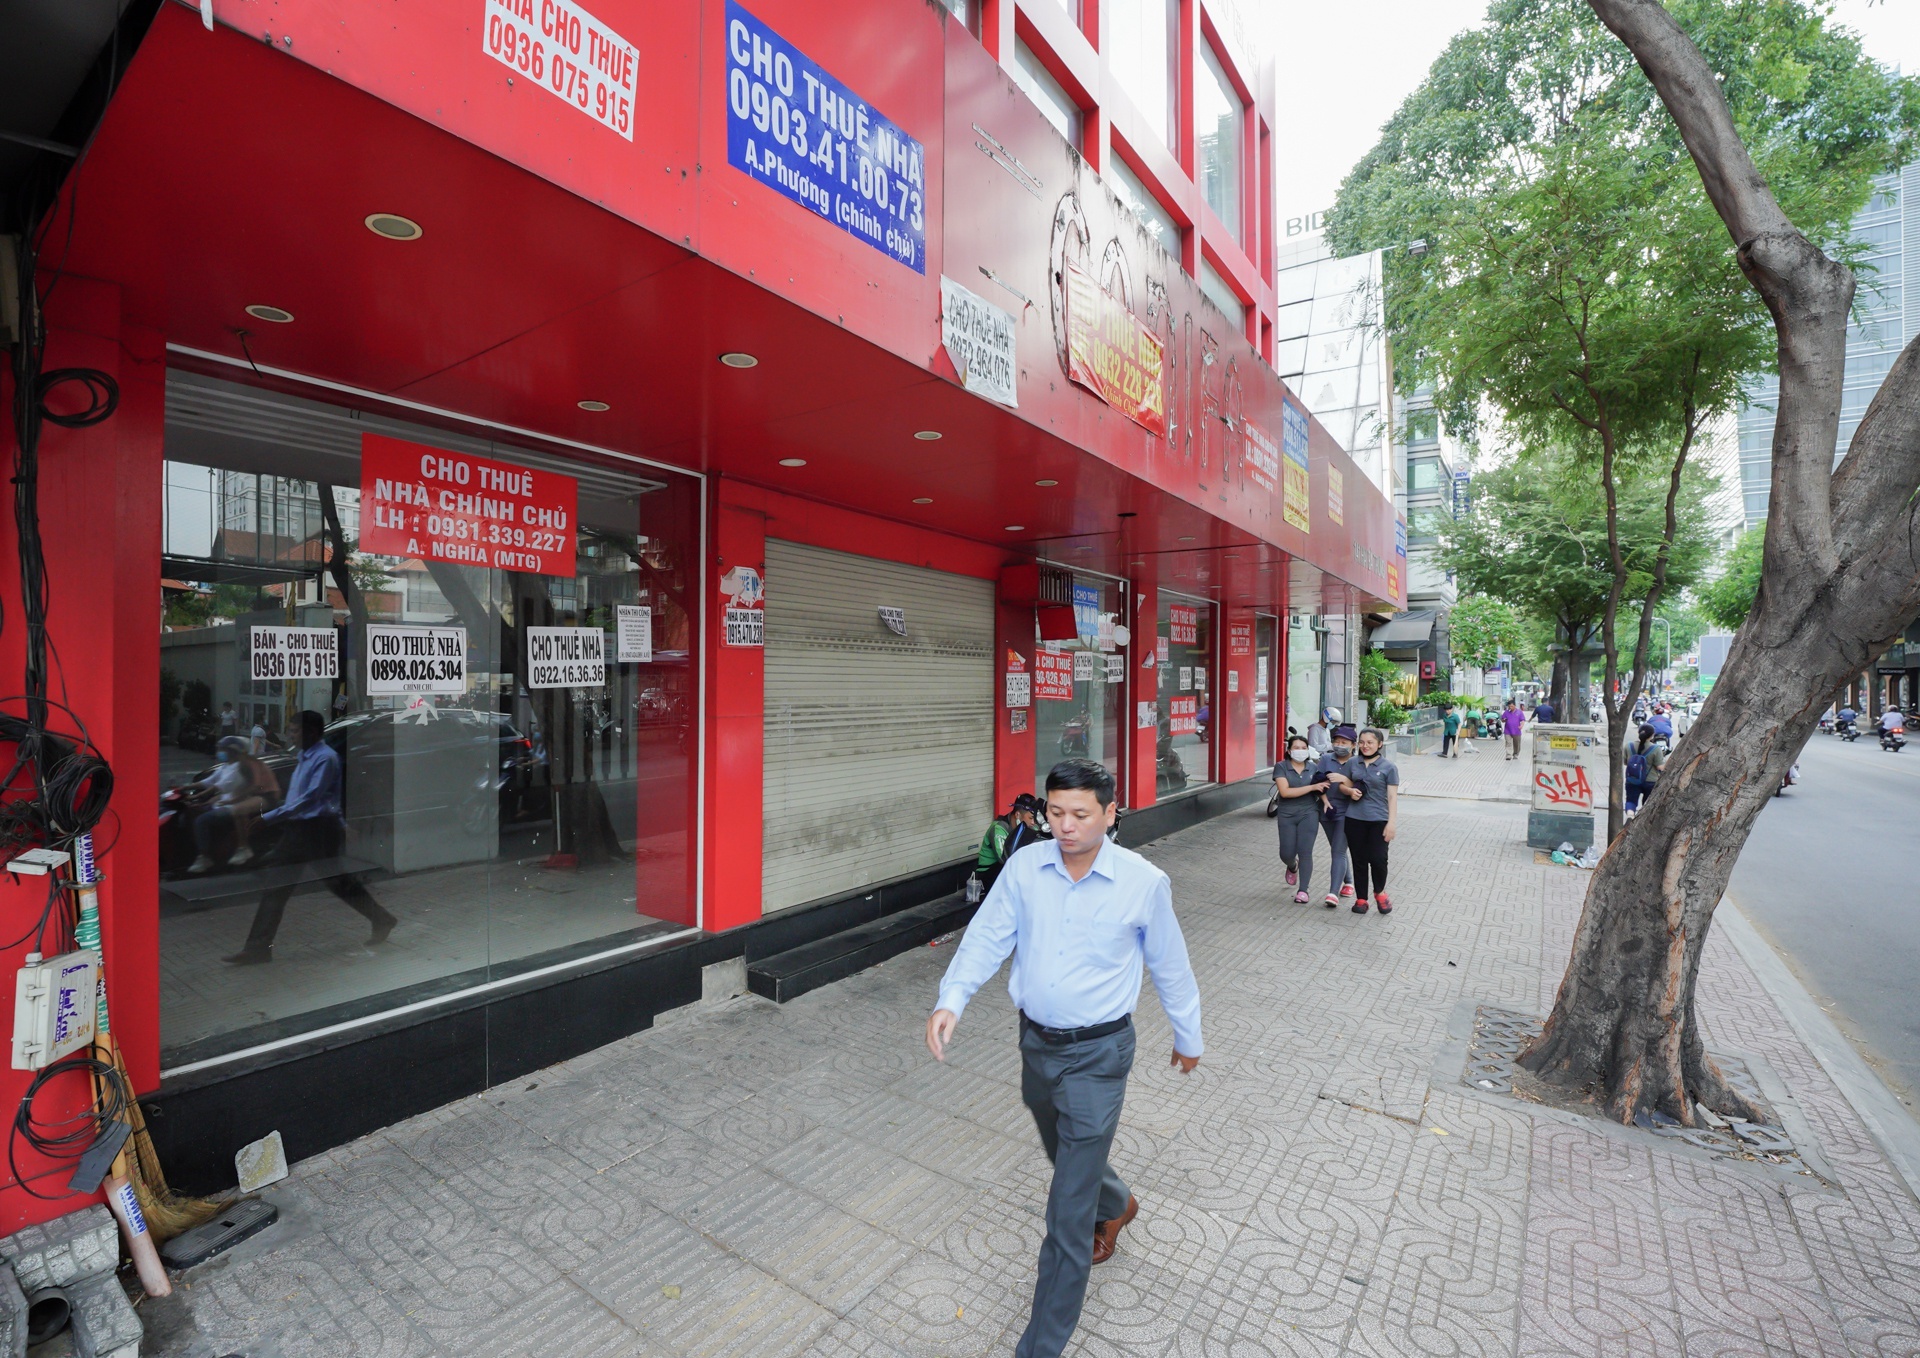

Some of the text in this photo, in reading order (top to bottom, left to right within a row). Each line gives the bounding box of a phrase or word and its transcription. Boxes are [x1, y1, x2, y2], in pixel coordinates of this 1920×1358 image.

[542, 0, 581, 55] CHO
[588, 27, 633, 91] THUÊ
[489, 14, 629, 133] 0936 075 915
[730, 19, 922, 189] CHO THUÊ NHÀ
[730, 68, 923, 231] 0903.41.00.73
[745, 138, 915, 265] A.Phượng (chính chủ)
[949, 294, 1010, 355] CHO THUÊ NHÀ
[1094, 337, 1121, 390] 0932
[1123, 360, 1142, 403] 228
[421, 454, 533, 497] CHO THUÊ
[375, 478, 567, 530] NHÀ CHÍNH CHỦ
[375, 506, 404, 530] LH
[427, 515, 566, 553] 0931.339.227
[406, 538, 542, 573] A. NGHĨA (MTG)
[727, 610, 738, 622] NHÀ
[739, 612, 749, 623] CHO
[254, 629, 276, 650] BÁN
[287, 634, 307, 650] CHO
[310, 631, 335, 650] THUÊ
[372, 631, 462, 657] CHO THUÊ NHÀ
[531, 635, 552, 661] CHO
[554, 629, 580, 660] THUÊ
[582, 629, 602, 660] NHÀ
[254, 652, 336, 677] 0936 075 915
[371, 659, 463, 681] 0898.026.304
[533, 664, 604, 684] 0922.16.36.36
[1041, 655, 1054, 669] CHO
[1056, 656, 1071, 671] THUÊ
